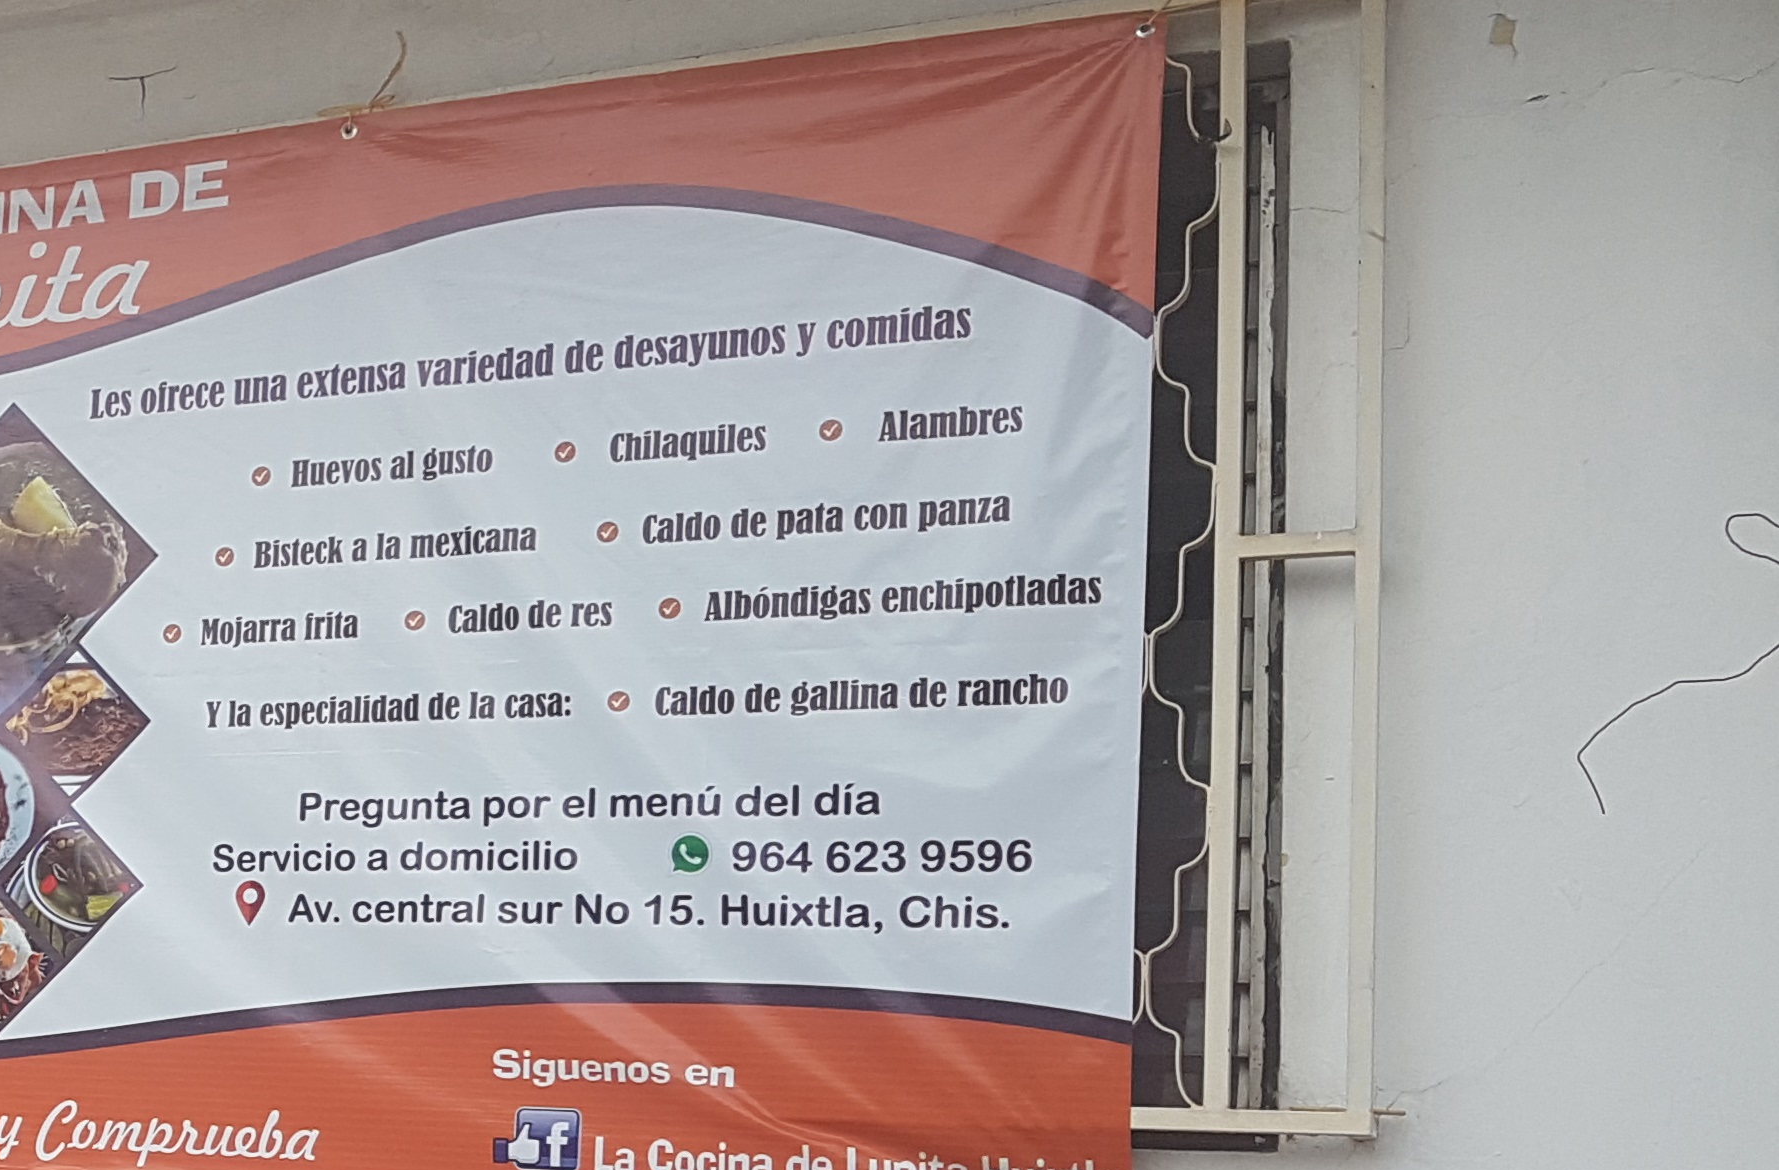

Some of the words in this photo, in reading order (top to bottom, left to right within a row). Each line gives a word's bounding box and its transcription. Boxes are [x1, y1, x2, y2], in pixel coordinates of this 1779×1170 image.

[128, 160, 229, 220] DE
[90, 388, 132, 419] Les
[141, 380, 225, 413] ofrece
[235, 373, 287, 405] una
[297, 361, 406, 400] extensa
[417, 343, 554, 388] variedad
[565, 340, 604, 373] de
[615, 324, 786, 369] desayunos
[796, 321, 816, 357] y
[826, 306, 972, 349] comidas
[610, 424, 767, 462] Chilaquiles
[879, 405, 1023, 442] Alambres
[291, 458, 382, 488] Huevos
[391, 451, 414, 480] al
[422, 445, 494, 481] gusto
[642, 512, 721, 544] Caldo
[731, 509, 767, 539] de
[776, 503, 844, 540] pata
[854, 502, 908, 532] con
[918, 495, 1011, 531] panza
[253, 537, 343, 568] Bisteck
[351, 541, 367, 562] a
[376, 533, 401, 560] la
[409, 525, 537, 558] mexicana
[448, 602, 519, 634] Caldo
[529, 600, 561, 629] de
[571, 601, 613, 627] res
[705, 586, 871, 622] Albóndigas
[882, 574, 1103, 613] enchipotladas
[201, 616, 296, 647] Mojarra
[304, 611, 358, 640] frita
[206, 702, 221, 728] Y
[227, 700, 251, 728] la
[260, 692, 420, 729] especialidad
[428, 692, 460, 720] de
[468, 691, 495, 719] la
[504, 692, 571, 719] casa:
[654, 685, 734, 717] Caldo
[745, 683, 780, 713] de
[790, 679, 898, 716] gallina
[909, 677, 947, 708] de
[957, 673, 1068, 707] rancho
[299, 791, 471, 827] Pregunta
[483, 795, 551, 826] por
[562, 788, 596, 819] el
[609, 786, 721, 818] menú
[735, 784, 800, 817] del
[814, 783, 881, 816] día
[213, 843, 356, 874] Servicio
[366, 849, 388, 872] a
[400, 841, 578, 872] domicilio
[731, 841, 813, 873] 964
[825, 841, 907, 874] 623
[920, 839, 1033, 873] 9596
[288, 894, 340, 924] Av.
[352, 893, 485, 924] central
[497, 901, 563, 925] sur
[575, 894, 630, 925] No
[644, 894, 705, 927] 15.
[721, 894, 884, 934] Huixtla,
[899, 894, 1010, 930] Chis.
[492, 1048, 671, 1087] Siguenos
[684, 1063, 735, 1088] en
[34, 1099, 321, 1168] Comprueba
